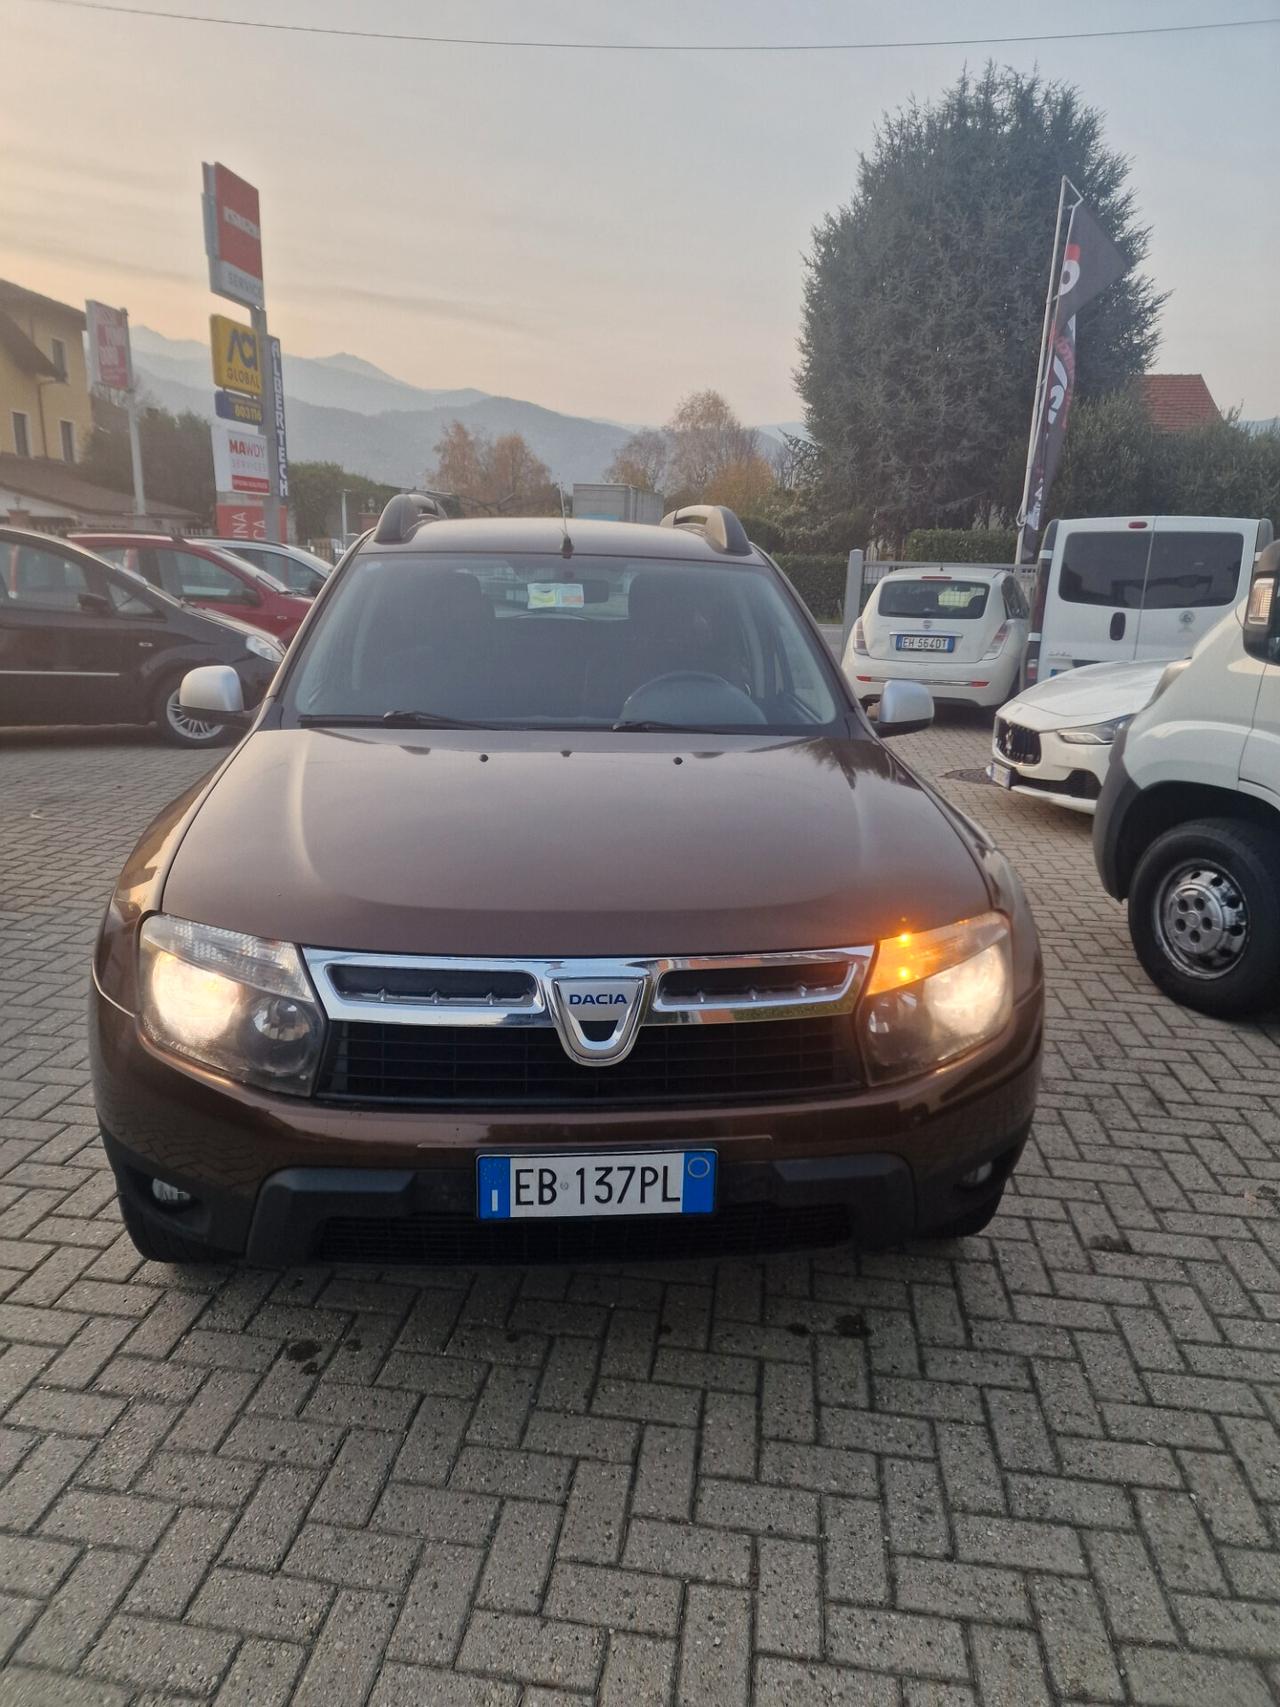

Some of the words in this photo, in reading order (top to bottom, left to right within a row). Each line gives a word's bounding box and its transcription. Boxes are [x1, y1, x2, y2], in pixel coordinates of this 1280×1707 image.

[226, 367, 262, 390] GLOBAL
[229, 440, 265, 458] MAWDY
[569, 993, 628, 1006] DACIA
[515, 1168, 558, 1206] EB
[575, 1165, 681, 1205] 137PL
